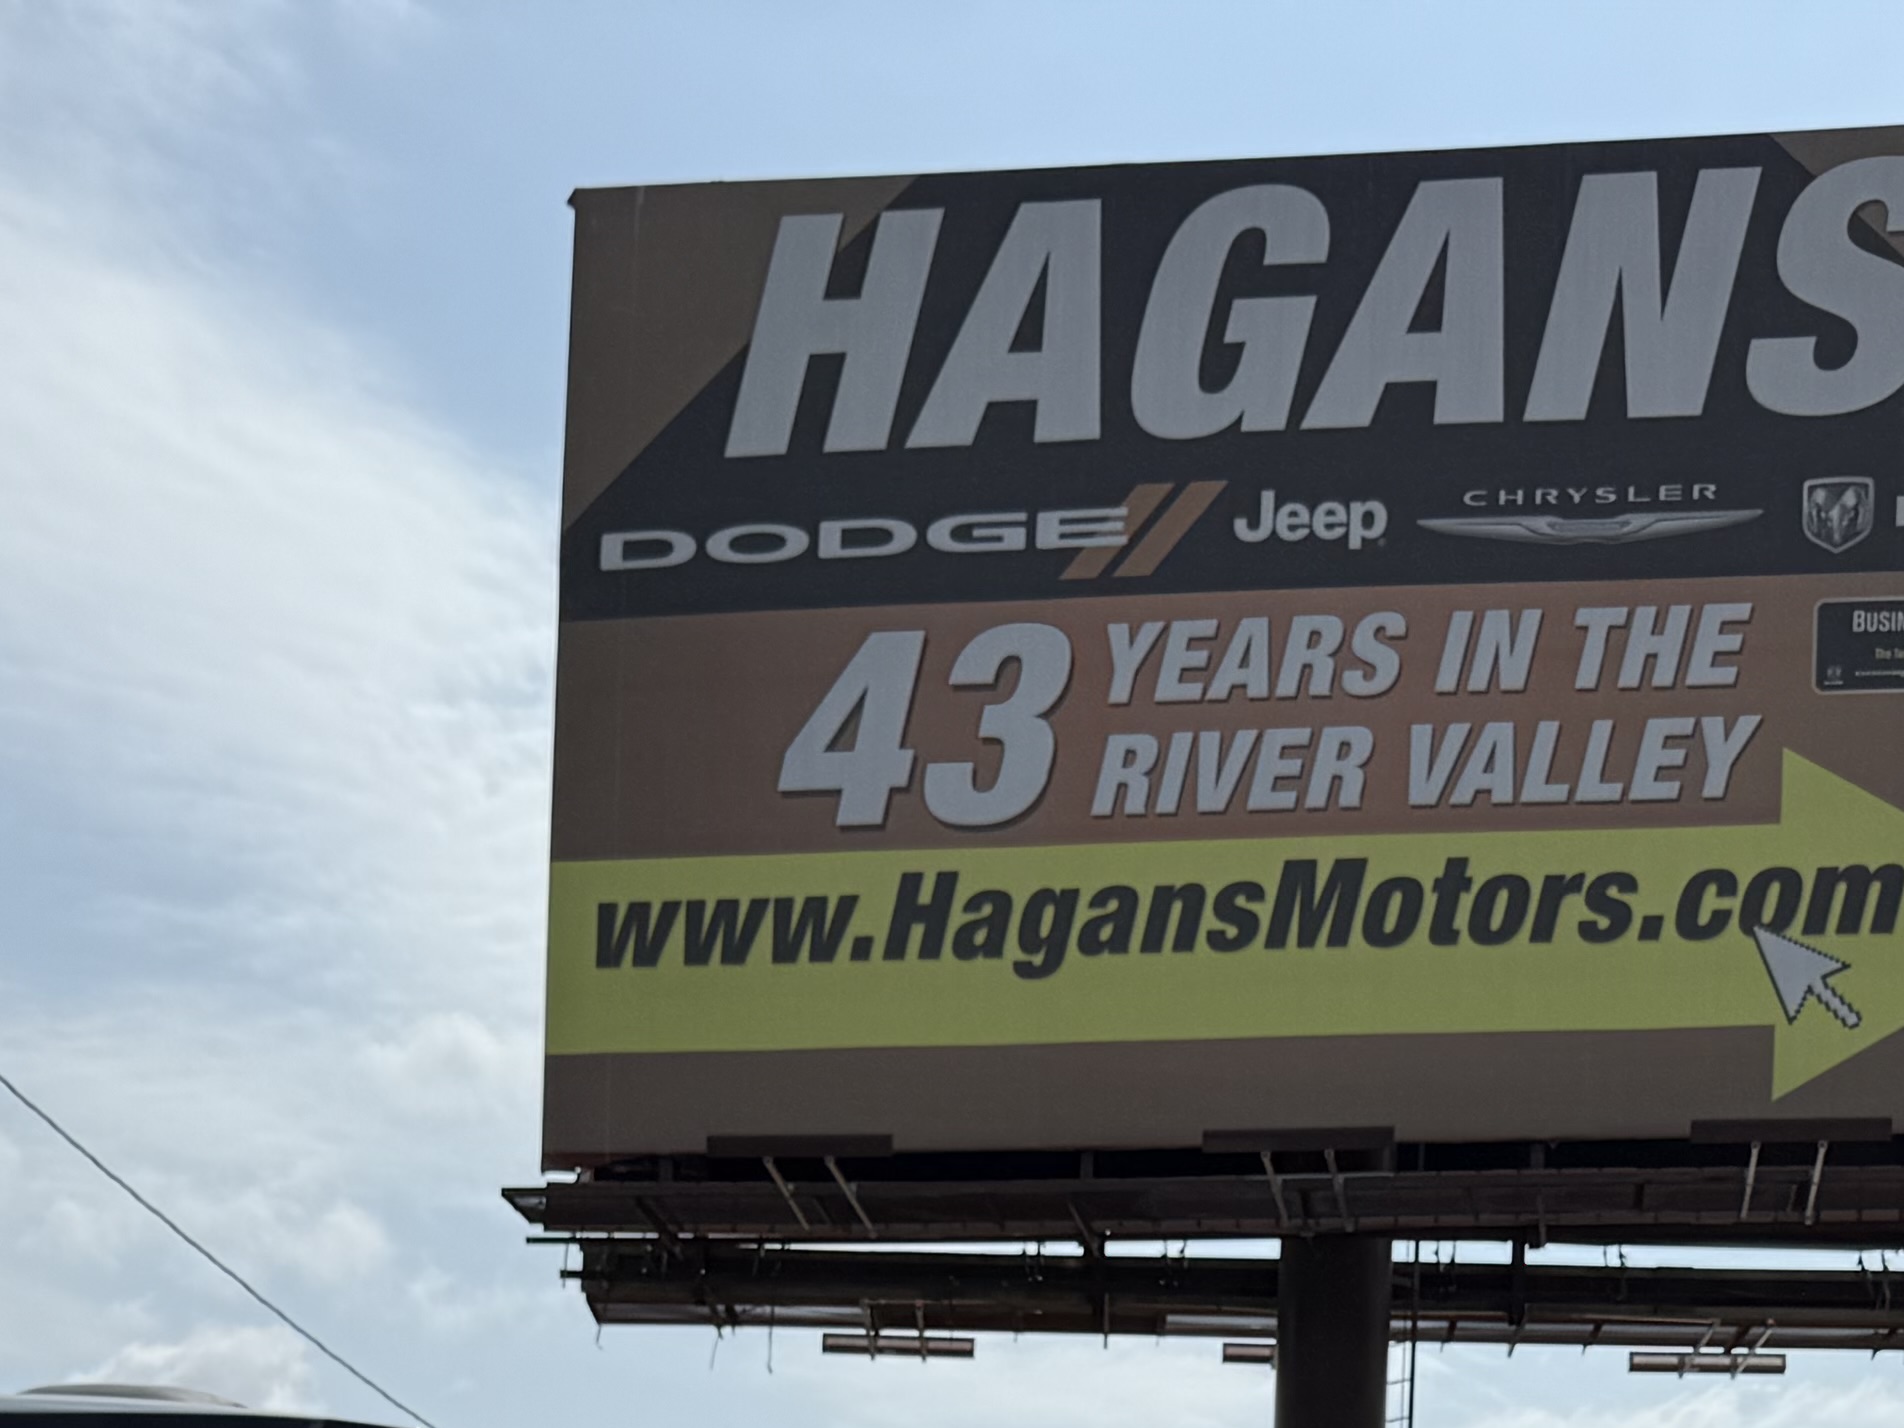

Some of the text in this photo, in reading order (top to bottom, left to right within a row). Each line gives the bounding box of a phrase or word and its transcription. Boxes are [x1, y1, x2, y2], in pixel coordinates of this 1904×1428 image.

[1233, 489, 1388, 550] Jeep
[1463, 482, 1717, 507] CHRYSLER
[600, 506, 1129, 571] DODGE
[1106, 602, 1754, 705] YEARS IN THE
[777, 622, 1075, 830] 43
[1091, 714, 1764, 818] RIVER VALLEY
